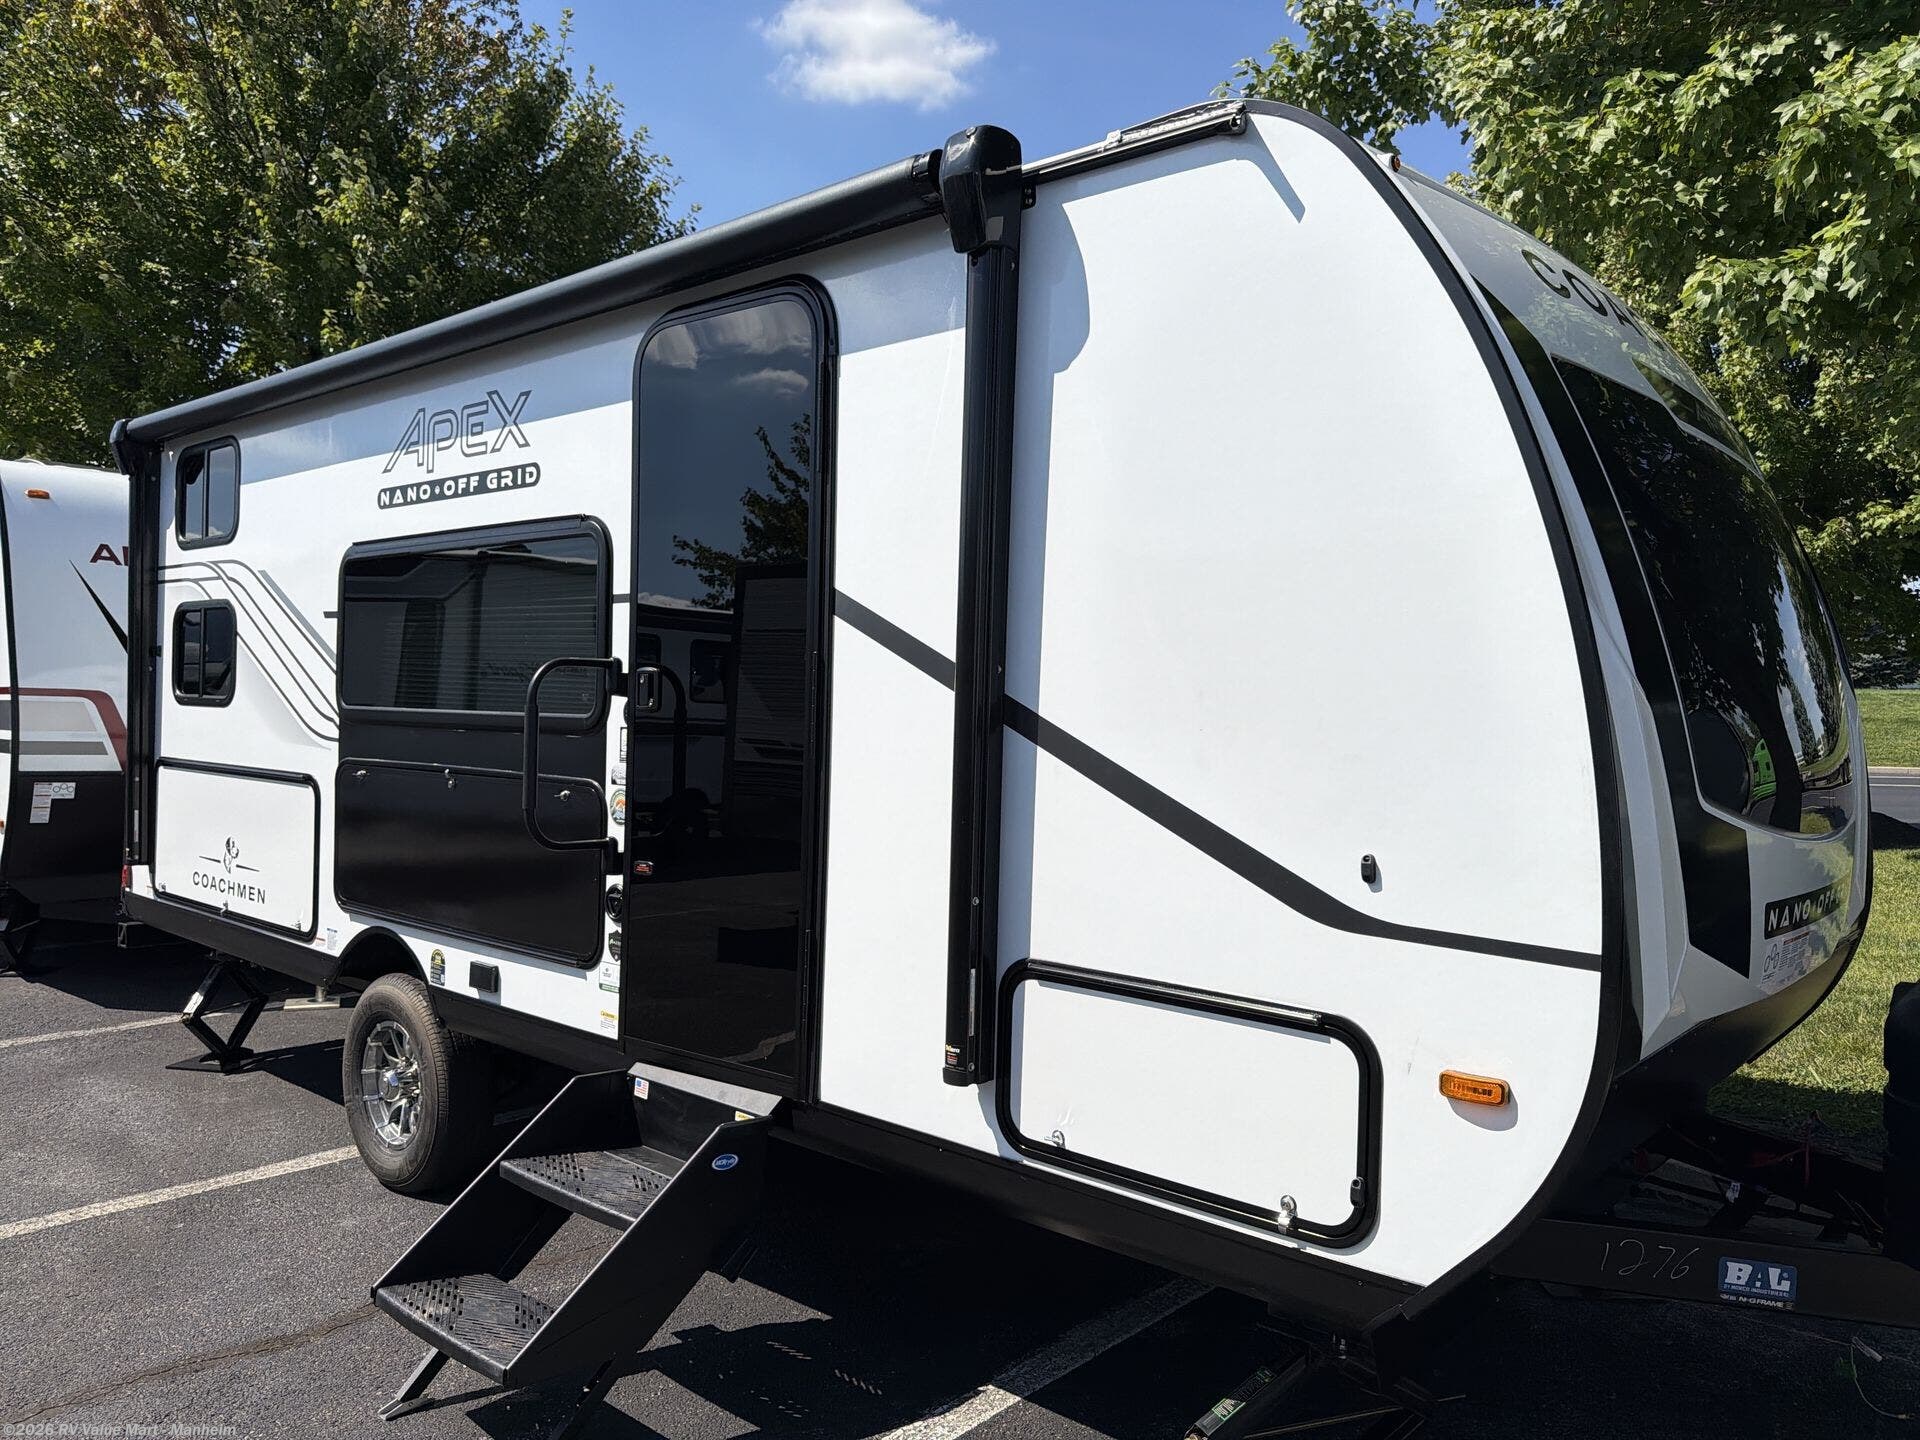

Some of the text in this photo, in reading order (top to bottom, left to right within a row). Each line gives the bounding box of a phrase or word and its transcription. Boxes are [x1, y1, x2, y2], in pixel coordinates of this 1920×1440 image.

[381, 389, 533, 474] APEX
[486, 466, 538, 490] GRID
[192, 871, 266, 905] COACHMEN
[1600, 1239, 1700, 1280] 1276
[1724, 1261, 1791, 1292] BAL
[1756, 1297, 1784, 1308] FRAME
